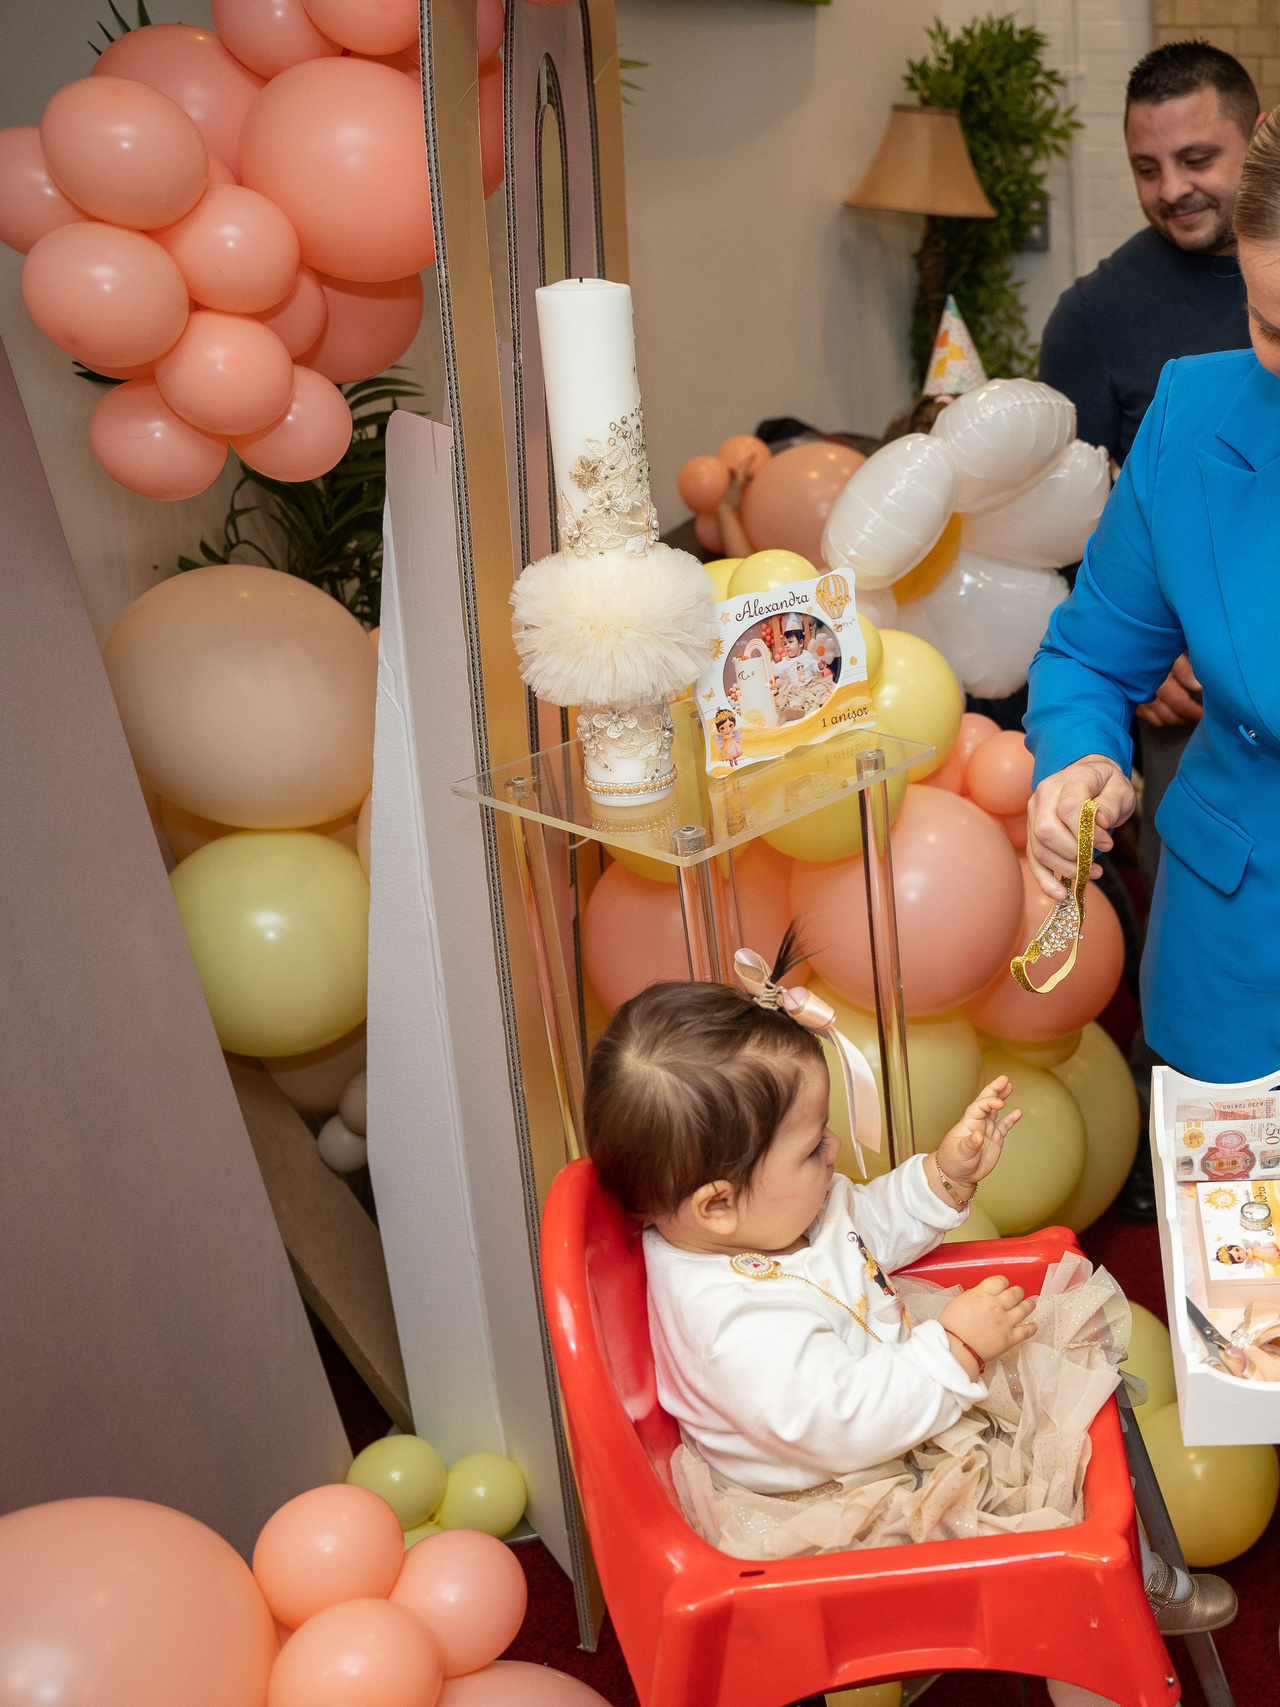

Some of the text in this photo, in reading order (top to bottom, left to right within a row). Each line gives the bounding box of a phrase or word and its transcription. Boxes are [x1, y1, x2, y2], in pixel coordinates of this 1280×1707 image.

[735, 591, 810, 622] Alexandra
[822, 719, 827, 728] 1
[1265, 1122, 1280, 1145] £50
